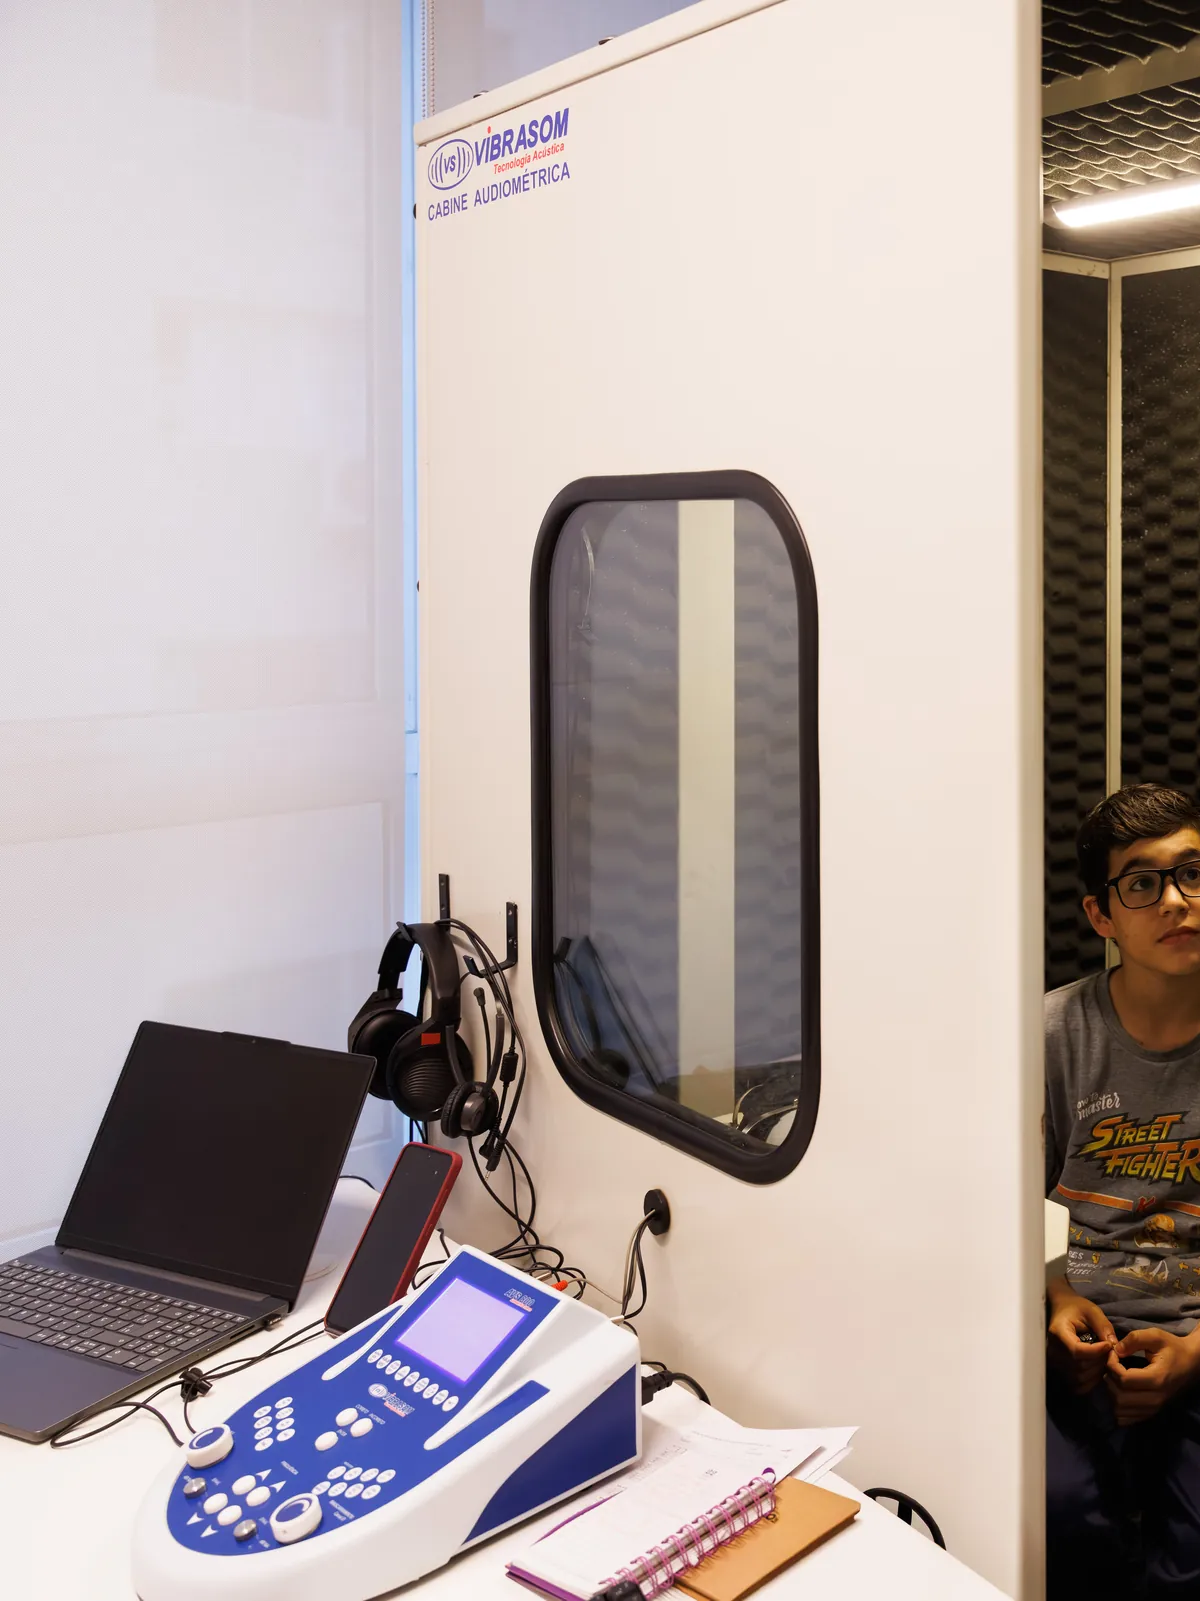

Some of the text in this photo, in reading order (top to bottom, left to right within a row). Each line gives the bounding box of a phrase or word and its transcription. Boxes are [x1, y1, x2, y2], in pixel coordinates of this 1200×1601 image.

[474, 107, 570, 166] VIBRASOM
[493, 142, 565, 175] Tecnologia Acústica
[443, 155, 456, 174] VS
[428, 161, 571, 221] CABINE AUDIOMÉTRICA
[1076, 1112, 1187, 1156] STREET
